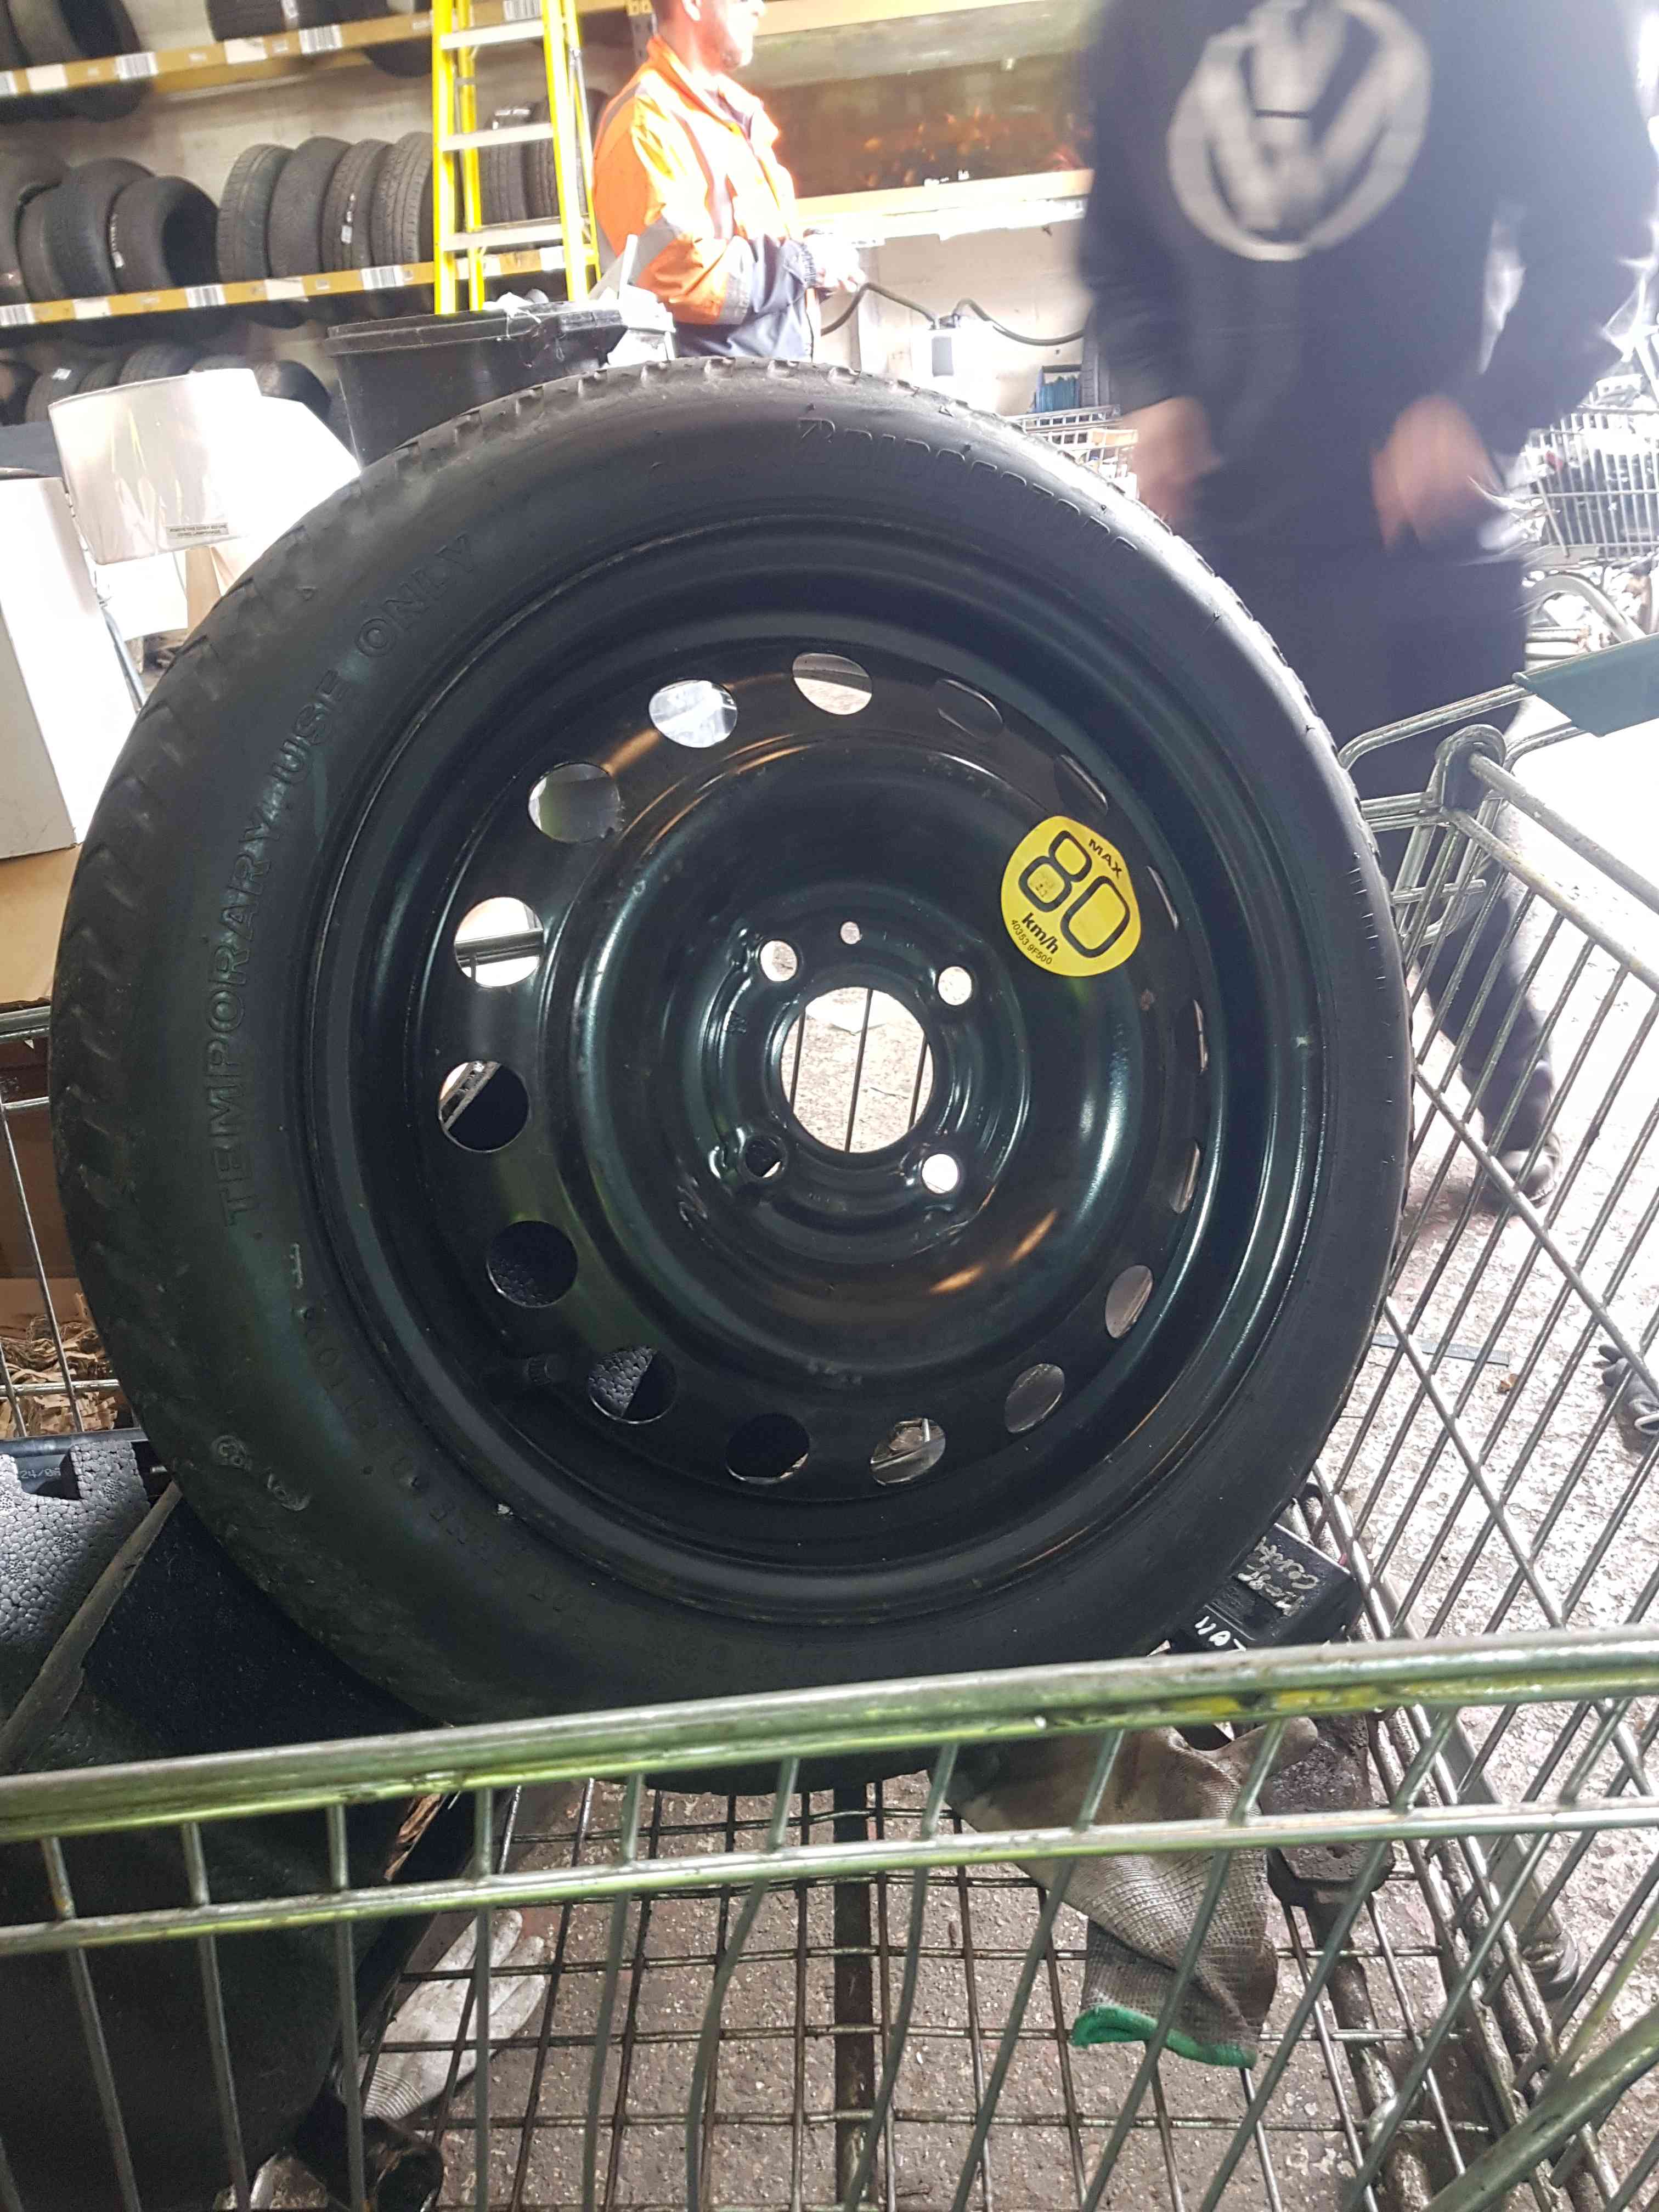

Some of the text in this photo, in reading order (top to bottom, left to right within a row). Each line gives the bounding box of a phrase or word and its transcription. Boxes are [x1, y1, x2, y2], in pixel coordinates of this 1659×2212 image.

[205, 531, 474, 1227] TEMPORARY USE ONLY
[1088, 839, 1122, 880] MAX
[1019, 831, 1130, 958] 80
[1011, 919, 1053, 965] 40353 9F500
[1022, 912, 1060, 954] km/h
